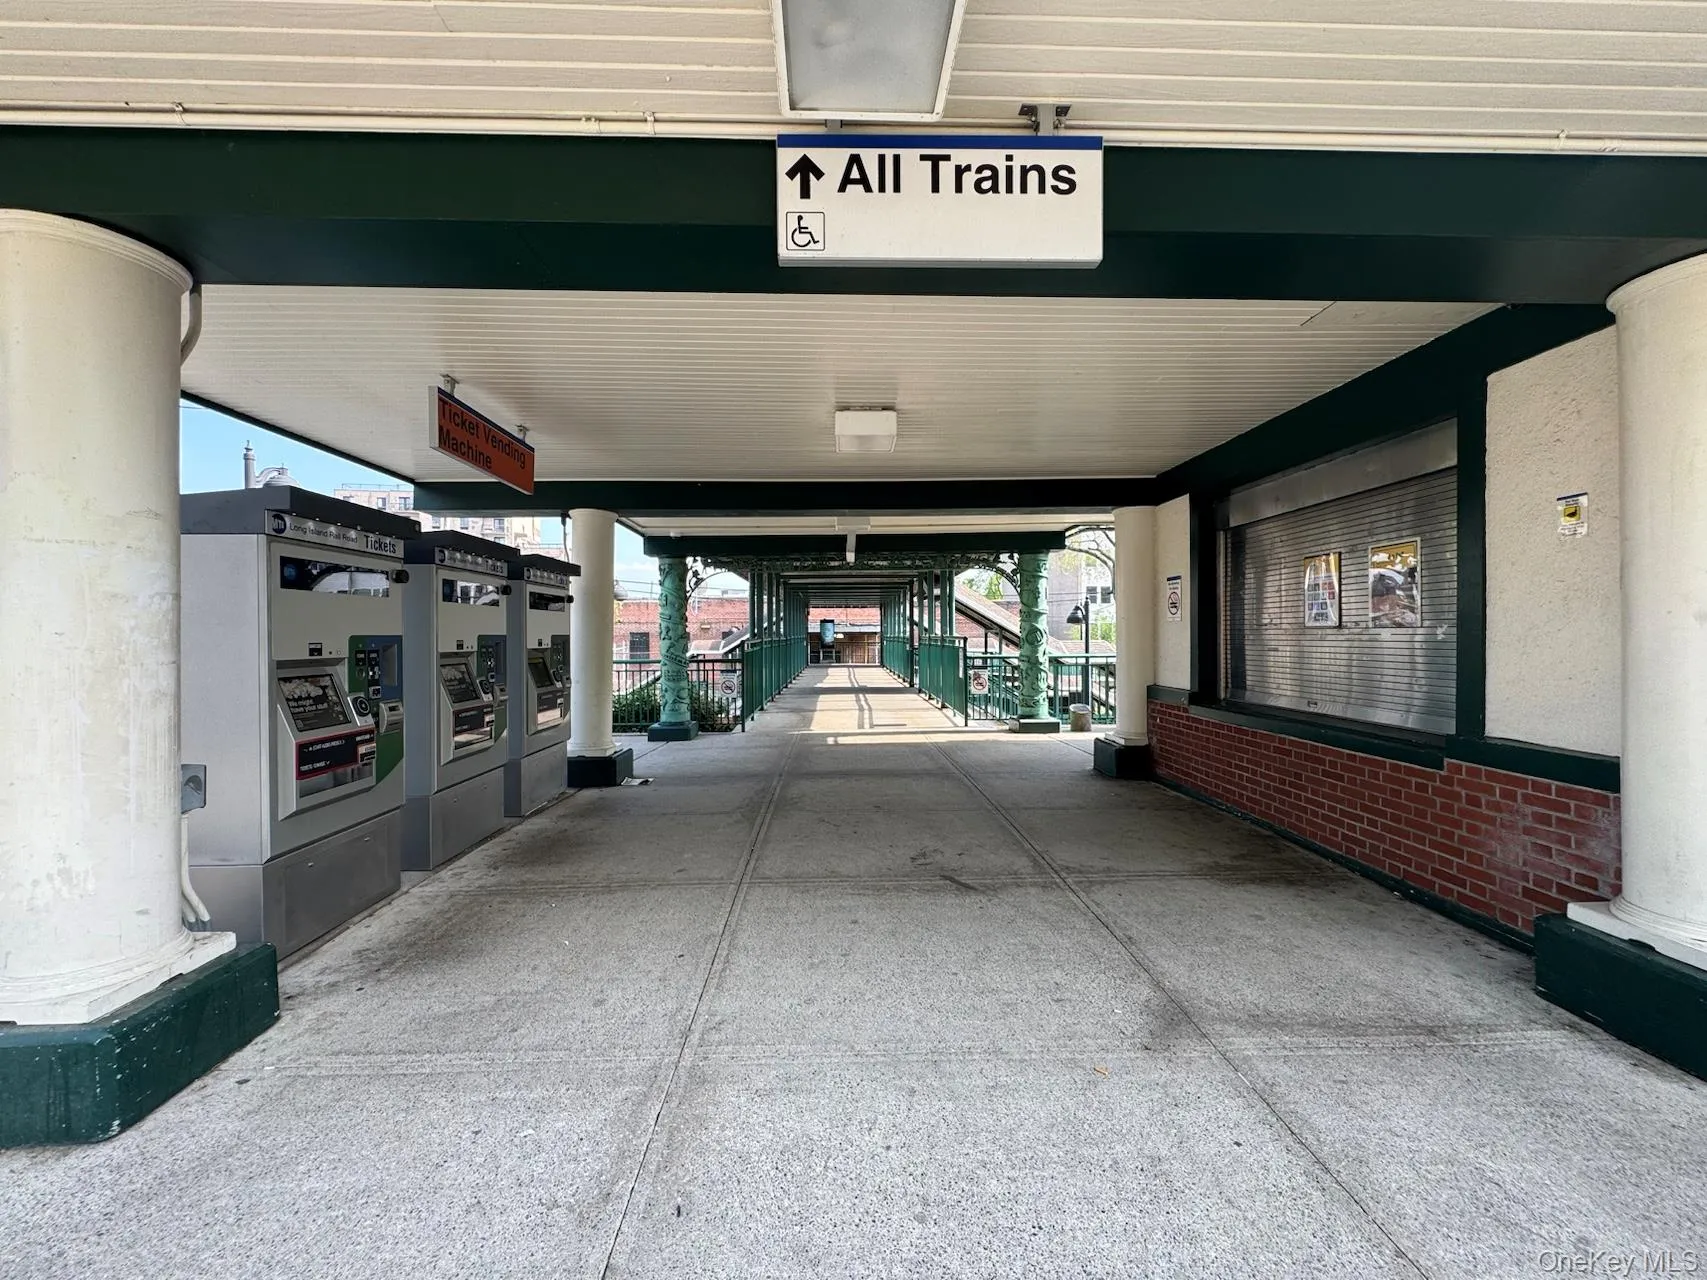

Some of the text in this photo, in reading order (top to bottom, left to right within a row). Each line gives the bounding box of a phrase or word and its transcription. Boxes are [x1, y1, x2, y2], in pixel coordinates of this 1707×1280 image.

[837, 153, 1078, 195] All Trains
[439, 399, 526, 469] Ticket Vending
[439, 425, 492, 469] Machine
[290, 522, 358, 544] Long Island Rail Road
[364, 534, 397, 554] Tickets
